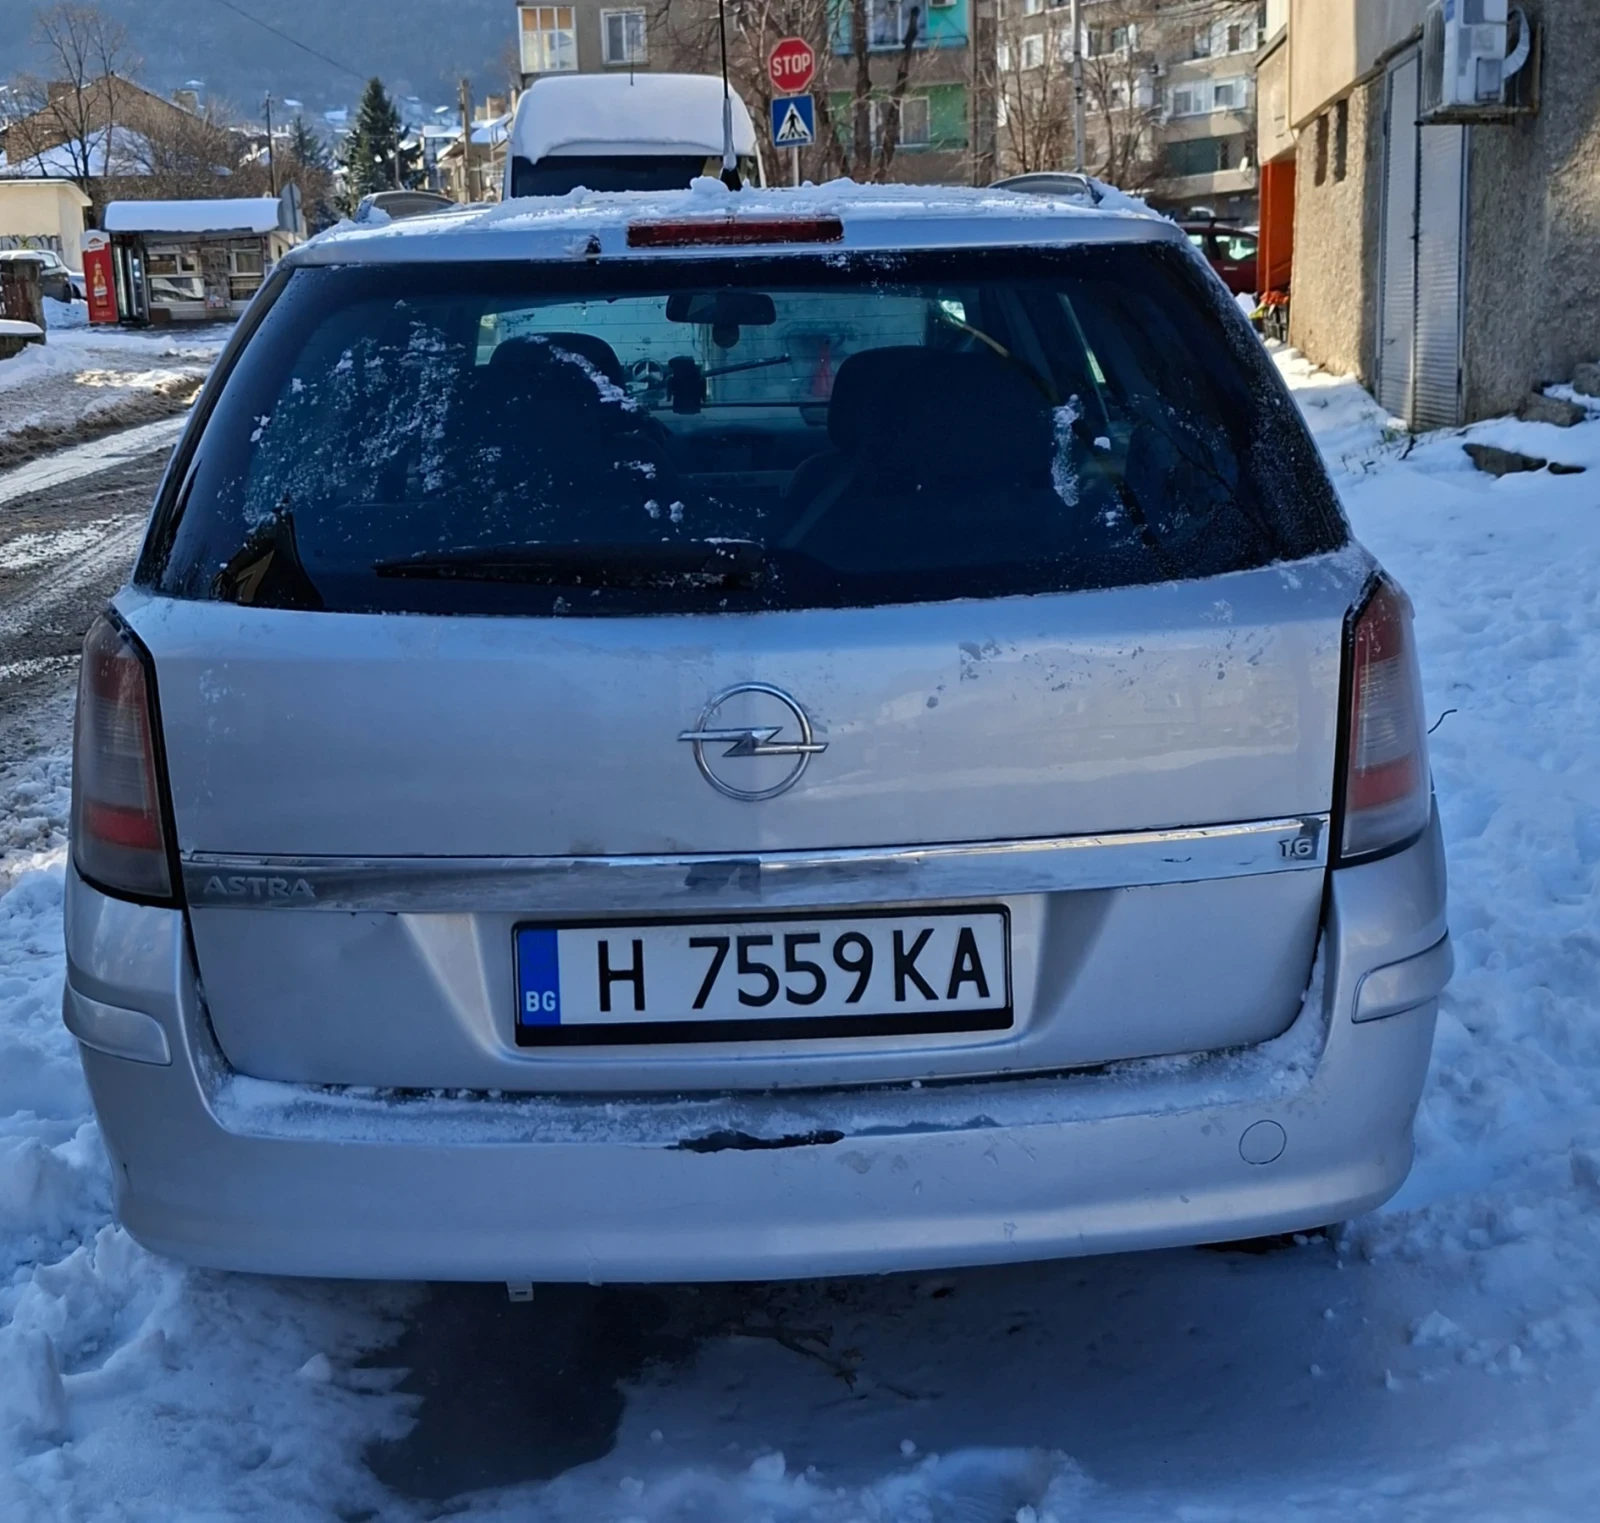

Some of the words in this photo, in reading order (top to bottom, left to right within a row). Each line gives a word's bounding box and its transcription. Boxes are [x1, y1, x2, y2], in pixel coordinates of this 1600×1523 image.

[772, 53, 811, 76] STOP
[203, 875, 316, 897] ASTRA
[597, 939, 646, 1012] H
[689, 931, 874, 1010] 7559
[893, 926, 991, 1003] KA
[525, 991, 556, 1012] BG
